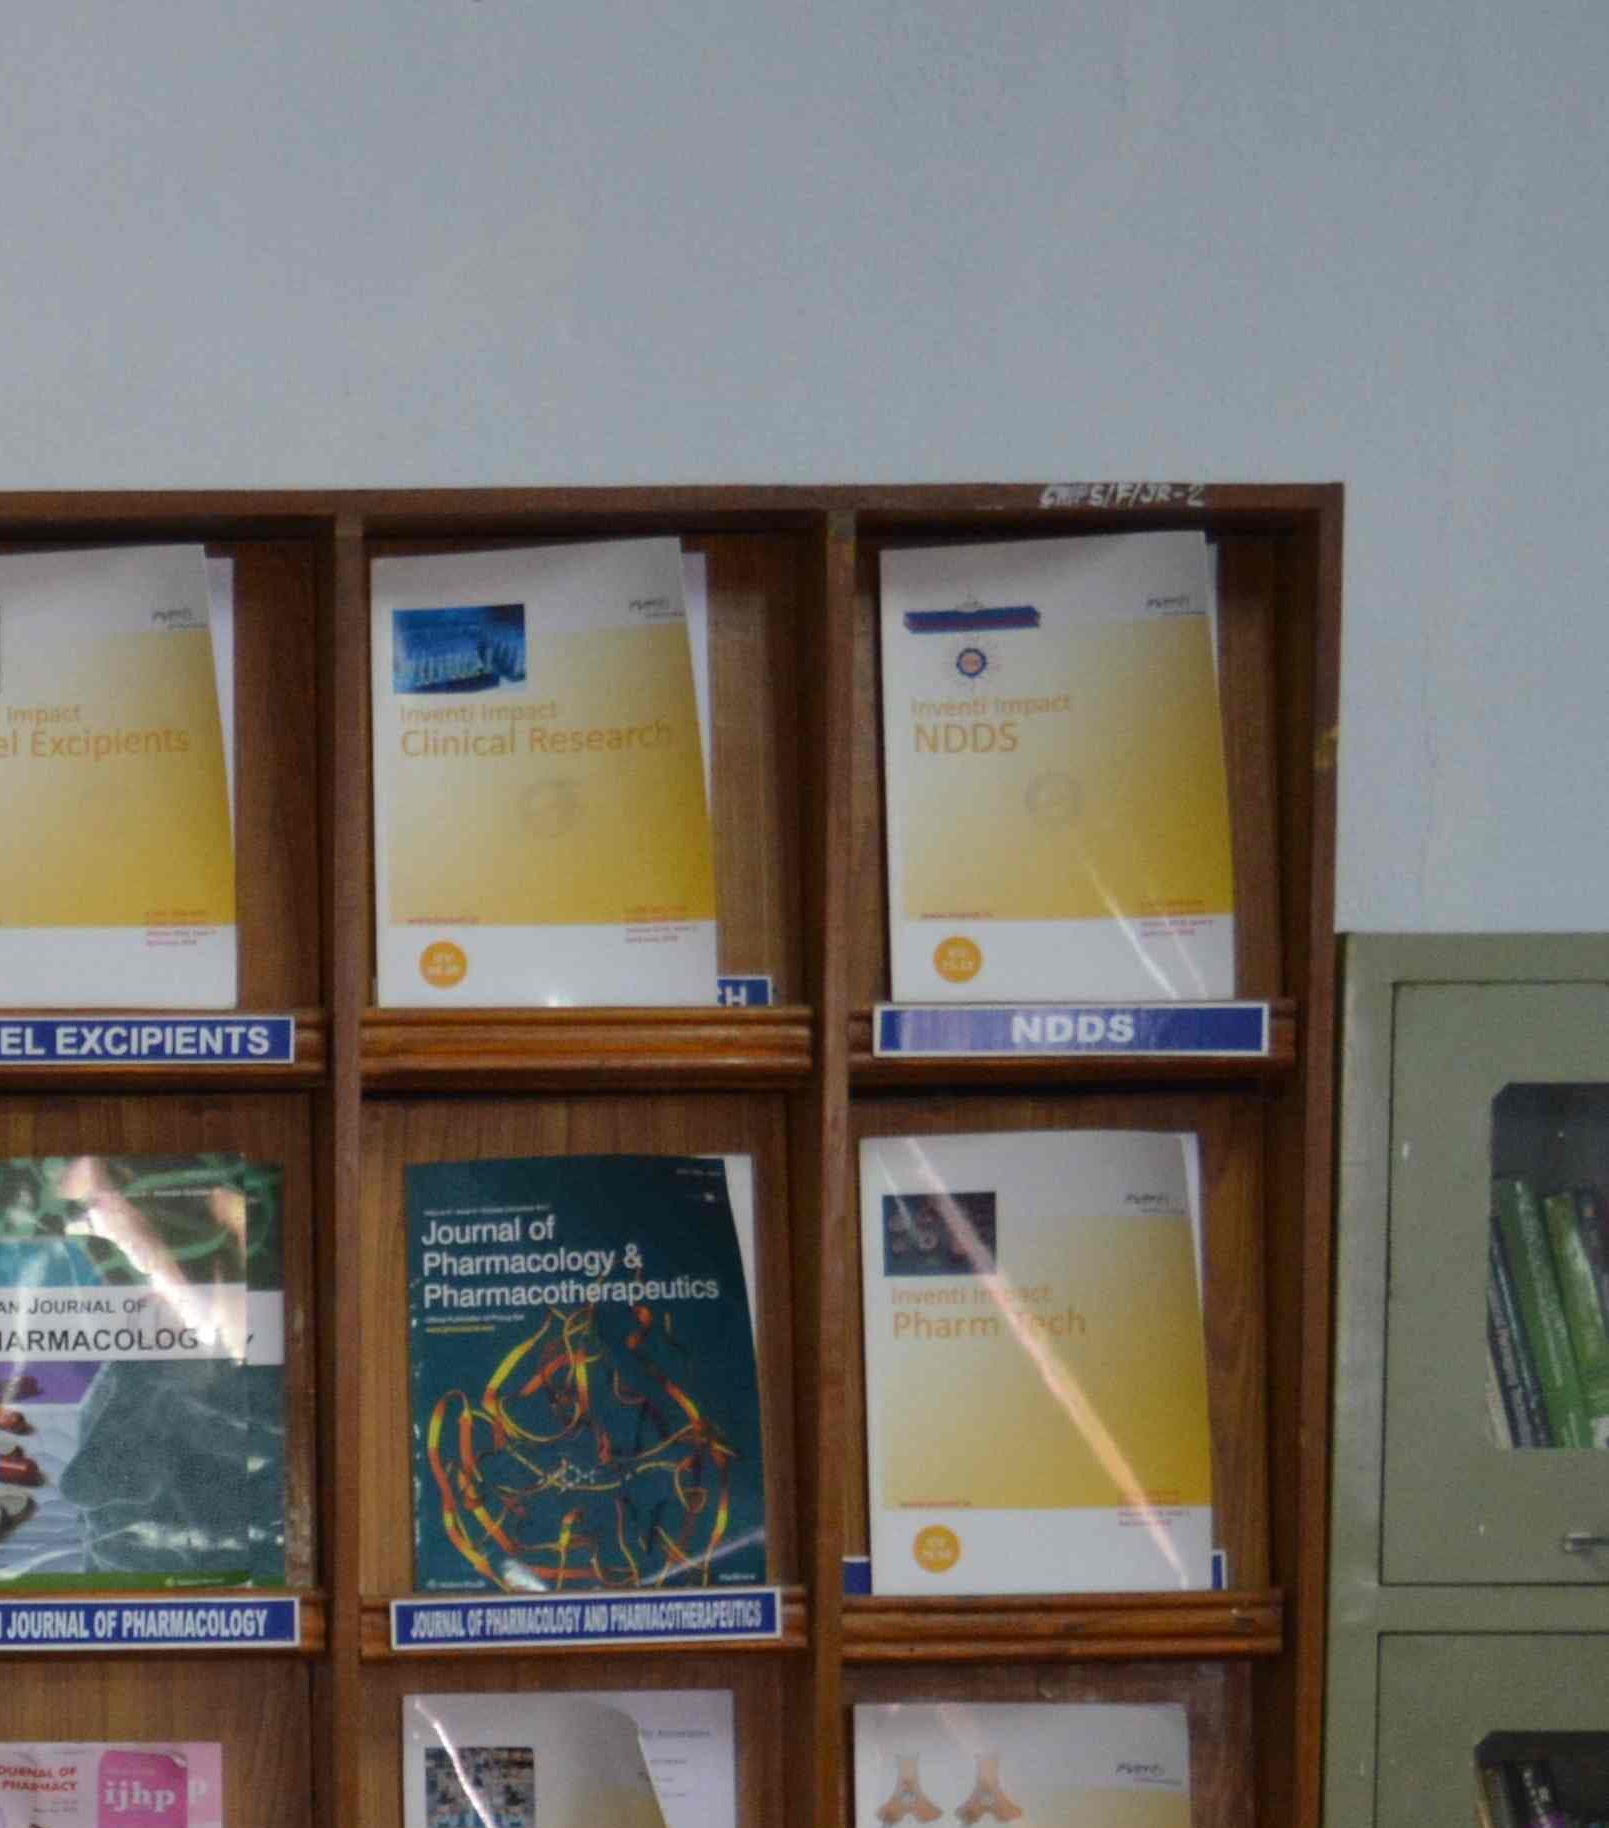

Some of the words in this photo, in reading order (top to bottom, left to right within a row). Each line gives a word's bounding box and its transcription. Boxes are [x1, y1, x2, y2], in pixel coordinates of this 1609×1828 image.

[30, 726, 190, 762] Excipients
[913, 722, 1020, 755] NDDS
[56, 1027, 270, 1056] EXCIPIENTS
[1011, 1015, 1135, 1044] NDDS
[421, 1218, 521, 1246] Journal
[528, 1214, 557, 1242] of
[423, 1247, 615, 1278] Pharmacology
[624, 1242, 643, 1269] &
[424, 1276, 720, 1309] Pharmacotherapeutics
[6, 1610, 89, 1639] JOURNAL
[93, 1610, 118, 1638] OF
[122, 1608, 268, 1638] PHARMACOLOGY
